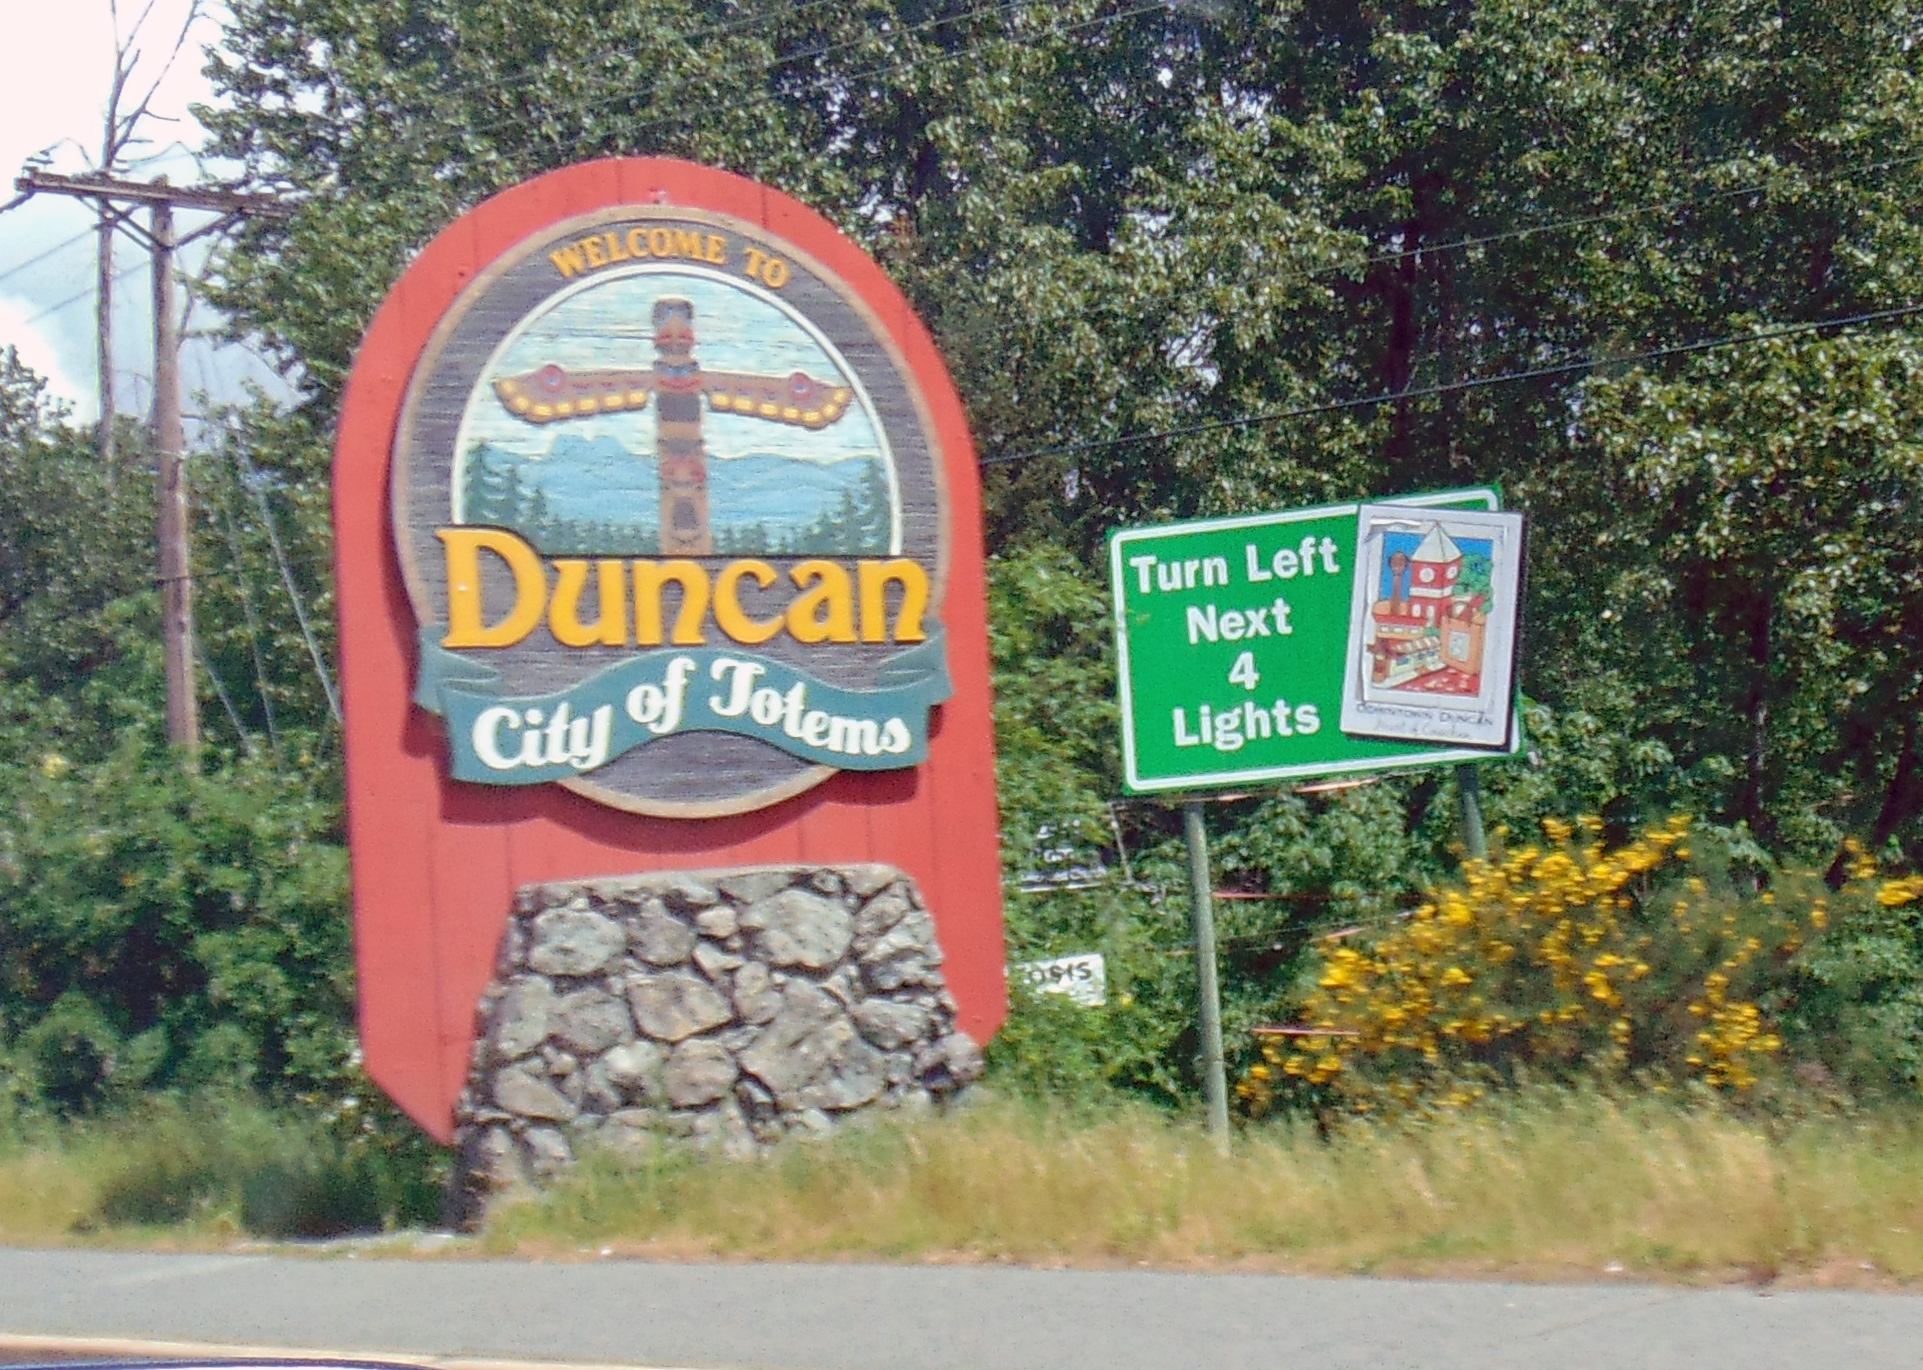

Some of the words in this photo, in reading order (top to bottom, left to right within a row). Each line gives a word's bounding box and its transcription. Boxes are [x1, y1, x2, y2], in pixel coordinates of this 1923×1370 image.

[550, 226, 728, 278] WELCOME
[744, 247, 790, 289] TO
[436, 528, 930, 648] Duncan
[1129, 555, 1229, 594] Turn
[1245, 536, 1341, 583] Left
[1186, 597, 1293, 645] Next
[1228, 651, 1260, 690] 4
[472, 702, 612, 769] City
[626, 656, 696, 734] of
[709, 657, 911, 755] Totems
[1172, 699, 1321, 751] Lights
